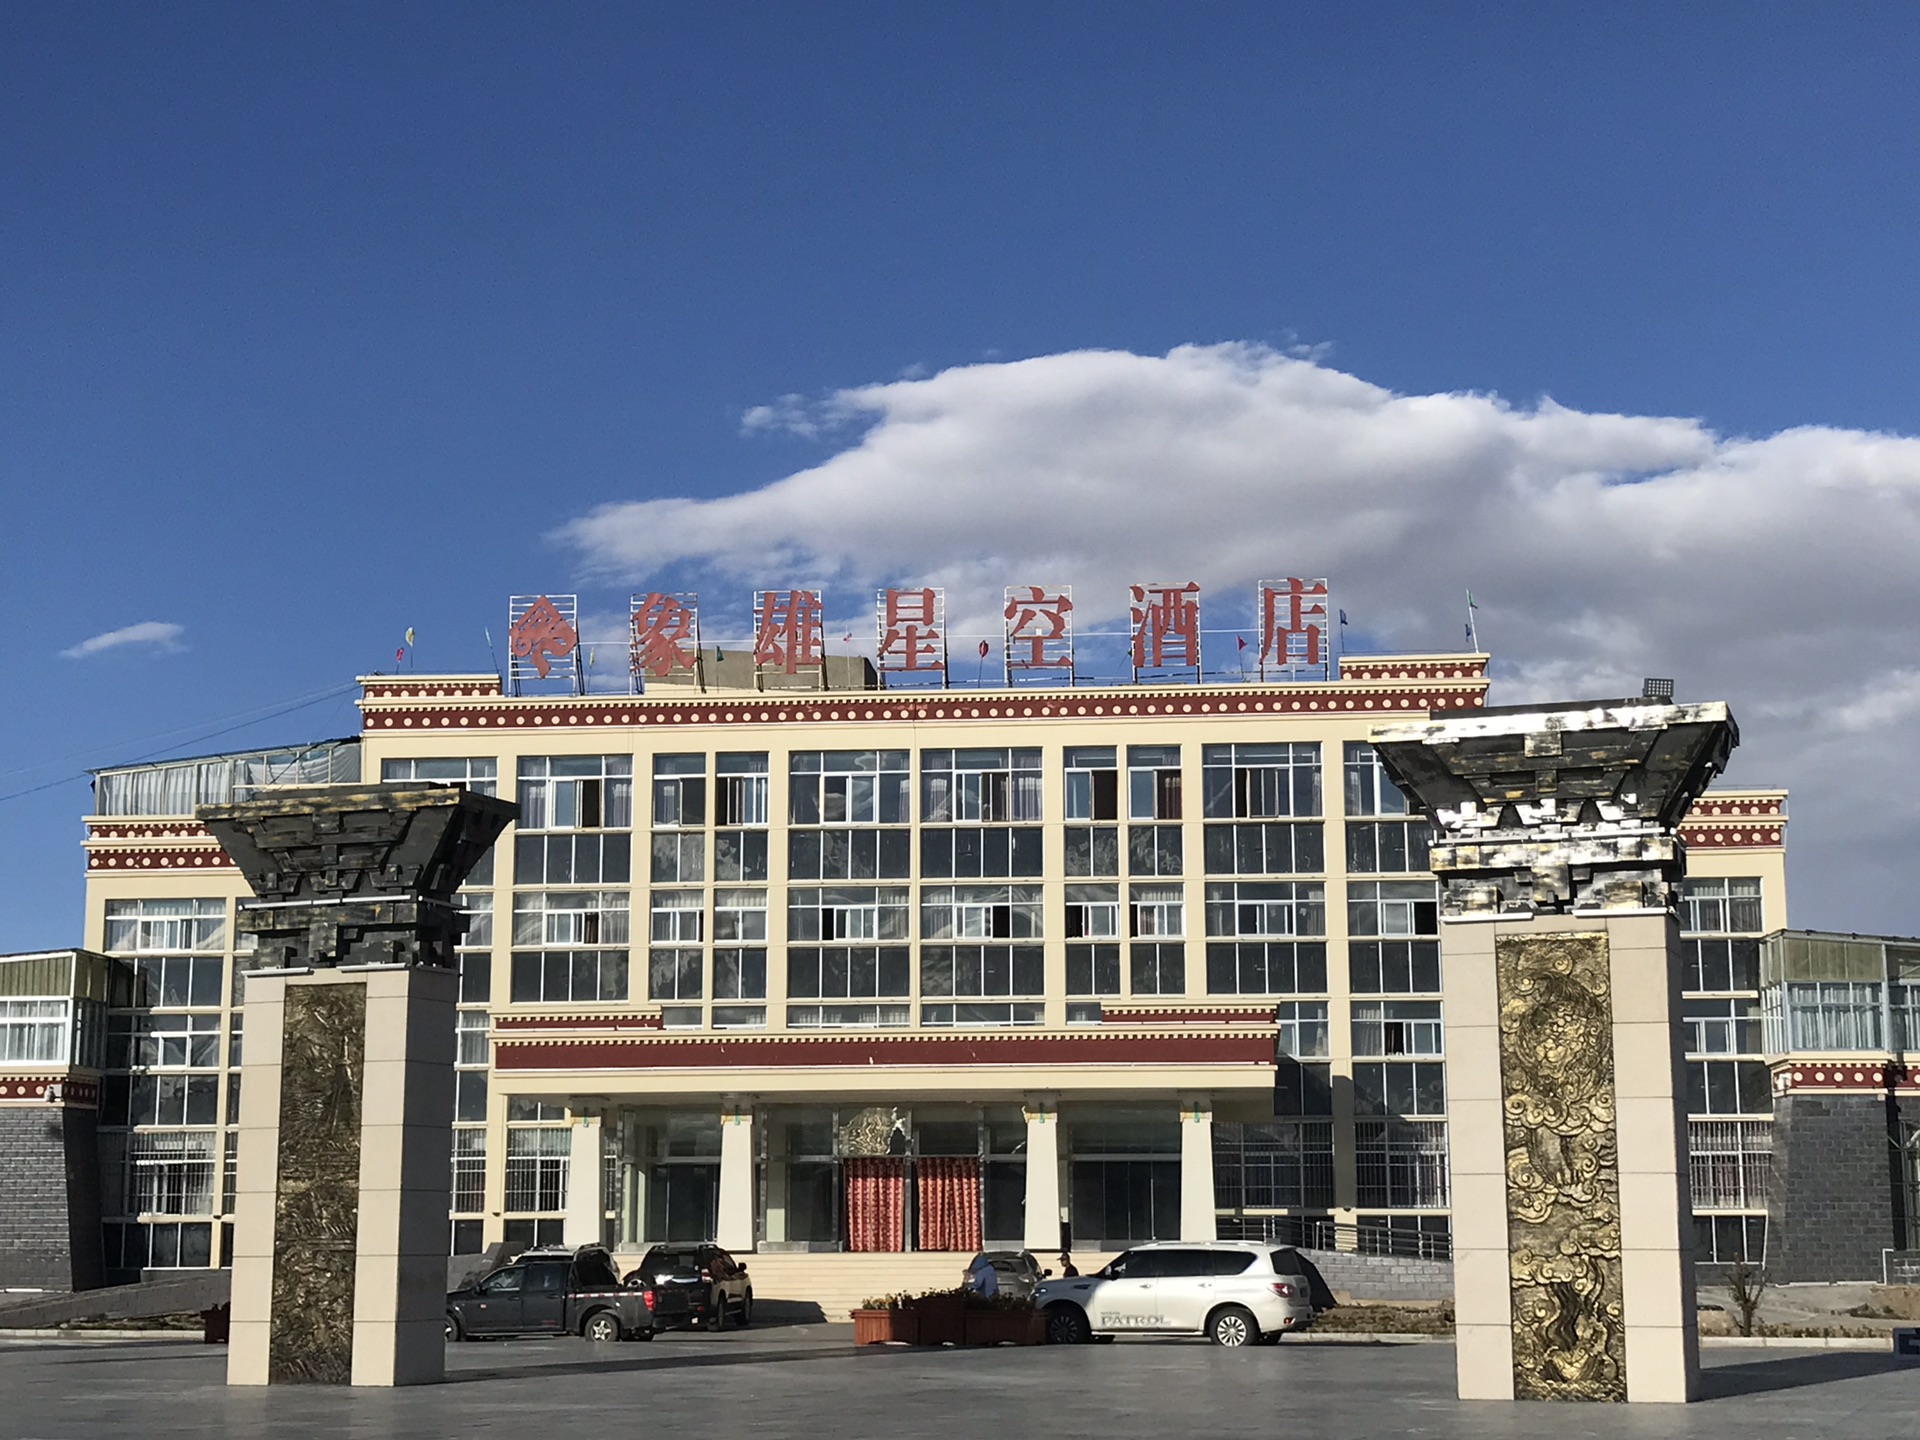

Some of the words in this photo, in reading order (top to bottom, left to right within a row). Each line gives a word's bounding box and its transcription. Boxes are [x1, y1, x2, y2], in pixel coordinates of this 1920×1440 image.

[629, 577, 1328, 677] 象雄星空酒店
[1101, 1315, 1170, 1326] PATROL
